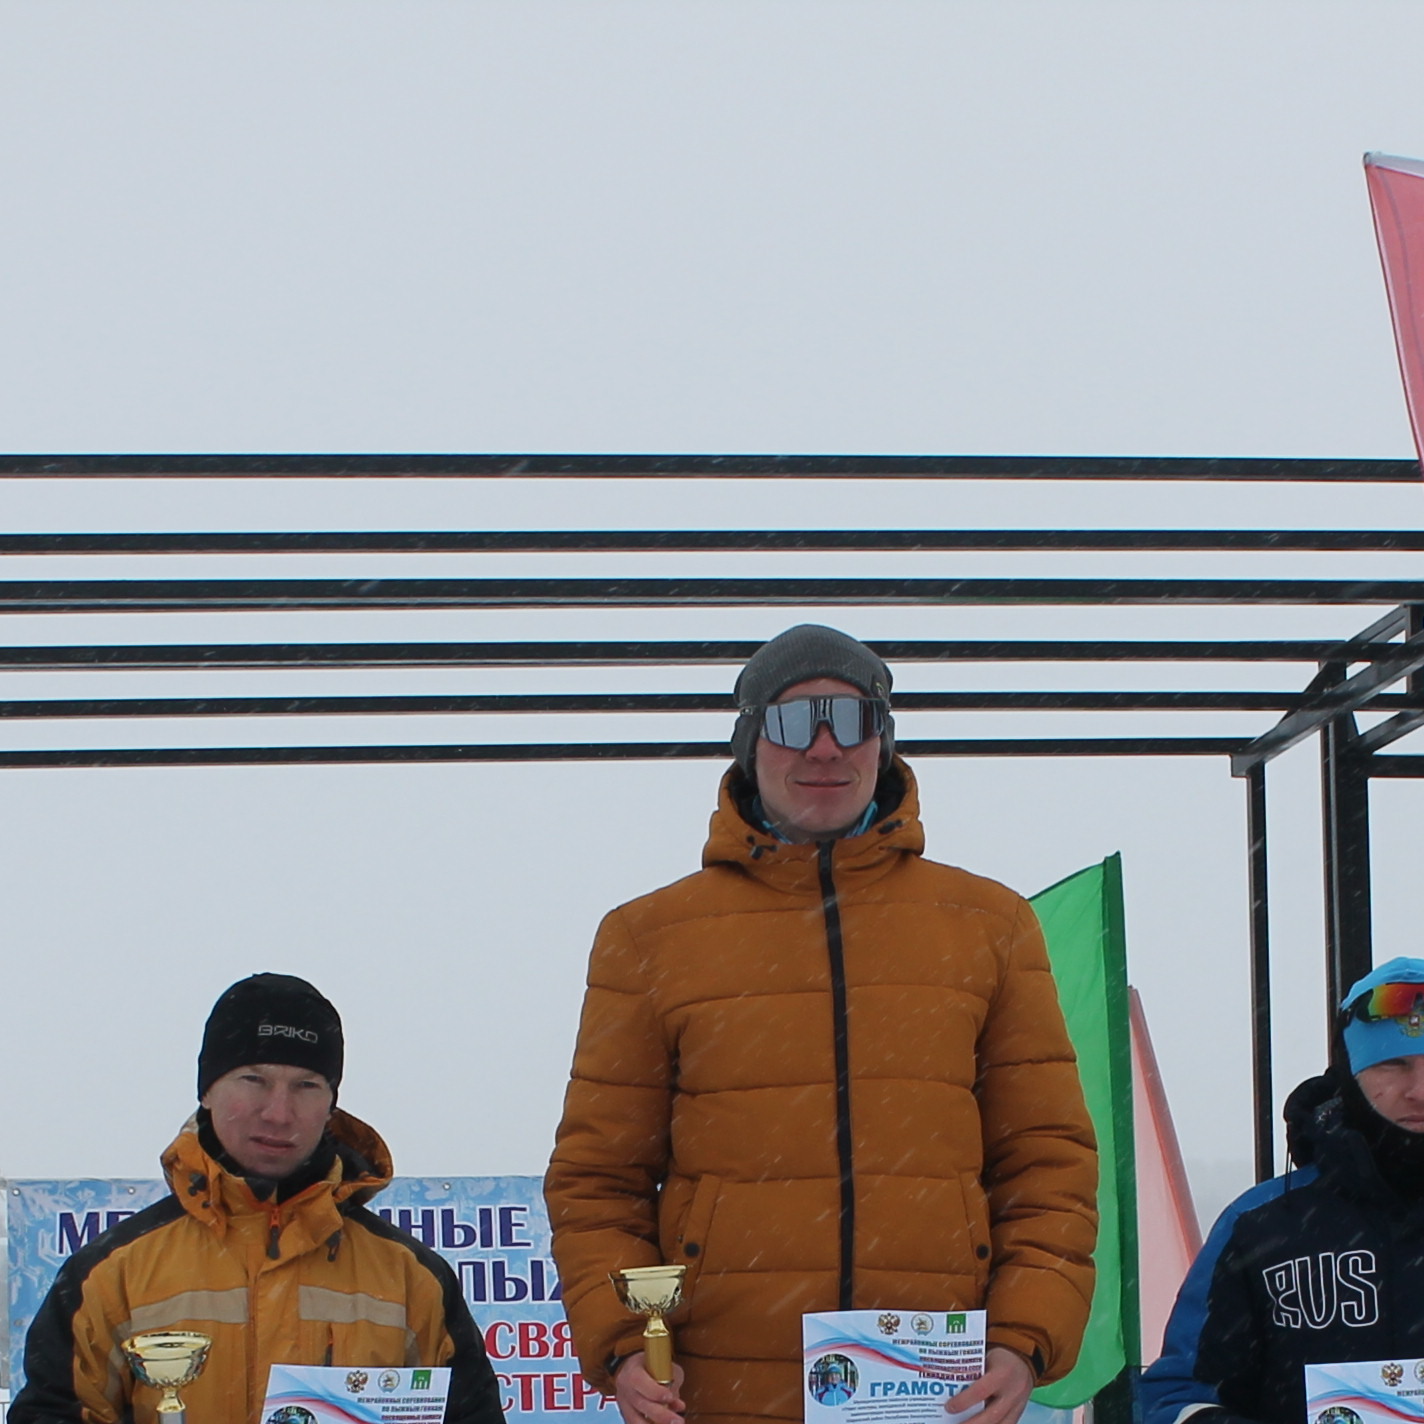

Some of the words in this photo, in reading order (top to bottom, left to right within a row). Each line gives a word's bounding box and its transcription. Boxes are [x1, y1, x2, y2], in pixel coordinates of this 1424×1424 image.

[258, 1024, 319, 1044] BRIKO
[379, 1206, 532, 1249] НЫЕ
[495, 1373, 619, 1411] СТЕР
[869, 1381, 971, 1398] ГРАМОТ
